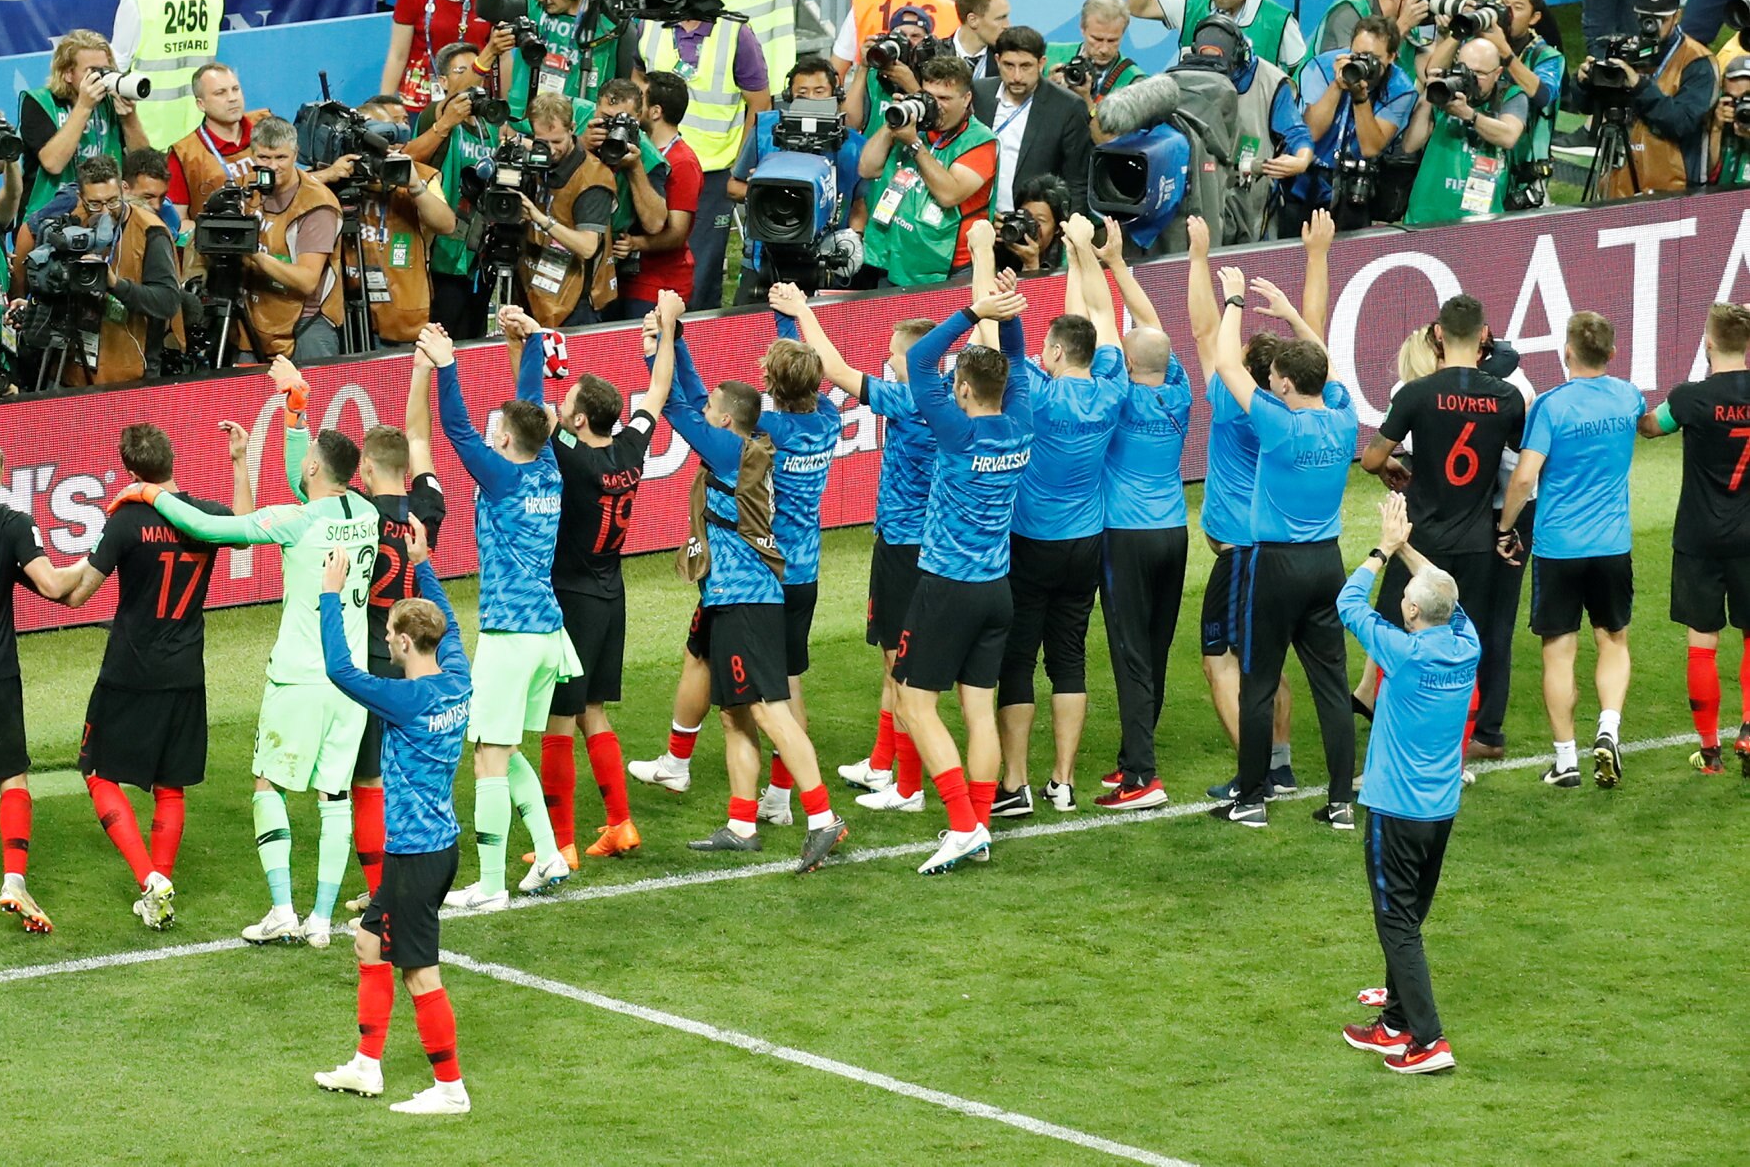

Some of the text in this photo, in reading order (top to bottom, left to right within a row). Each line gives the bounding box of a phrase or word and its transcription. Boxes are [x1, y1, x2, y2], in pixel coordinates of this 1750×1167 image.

[163, 39, 210, 54] STEWARD
[1437, 393, 1498, 413] LOVREN
[1444, 421, 1480, 486] 6
[1728, 427, 1750, 491] 7
[595, 491, 636, 553] 19
[156, 551, 209, 621] 17
[730, 654, 747, 684] 8
